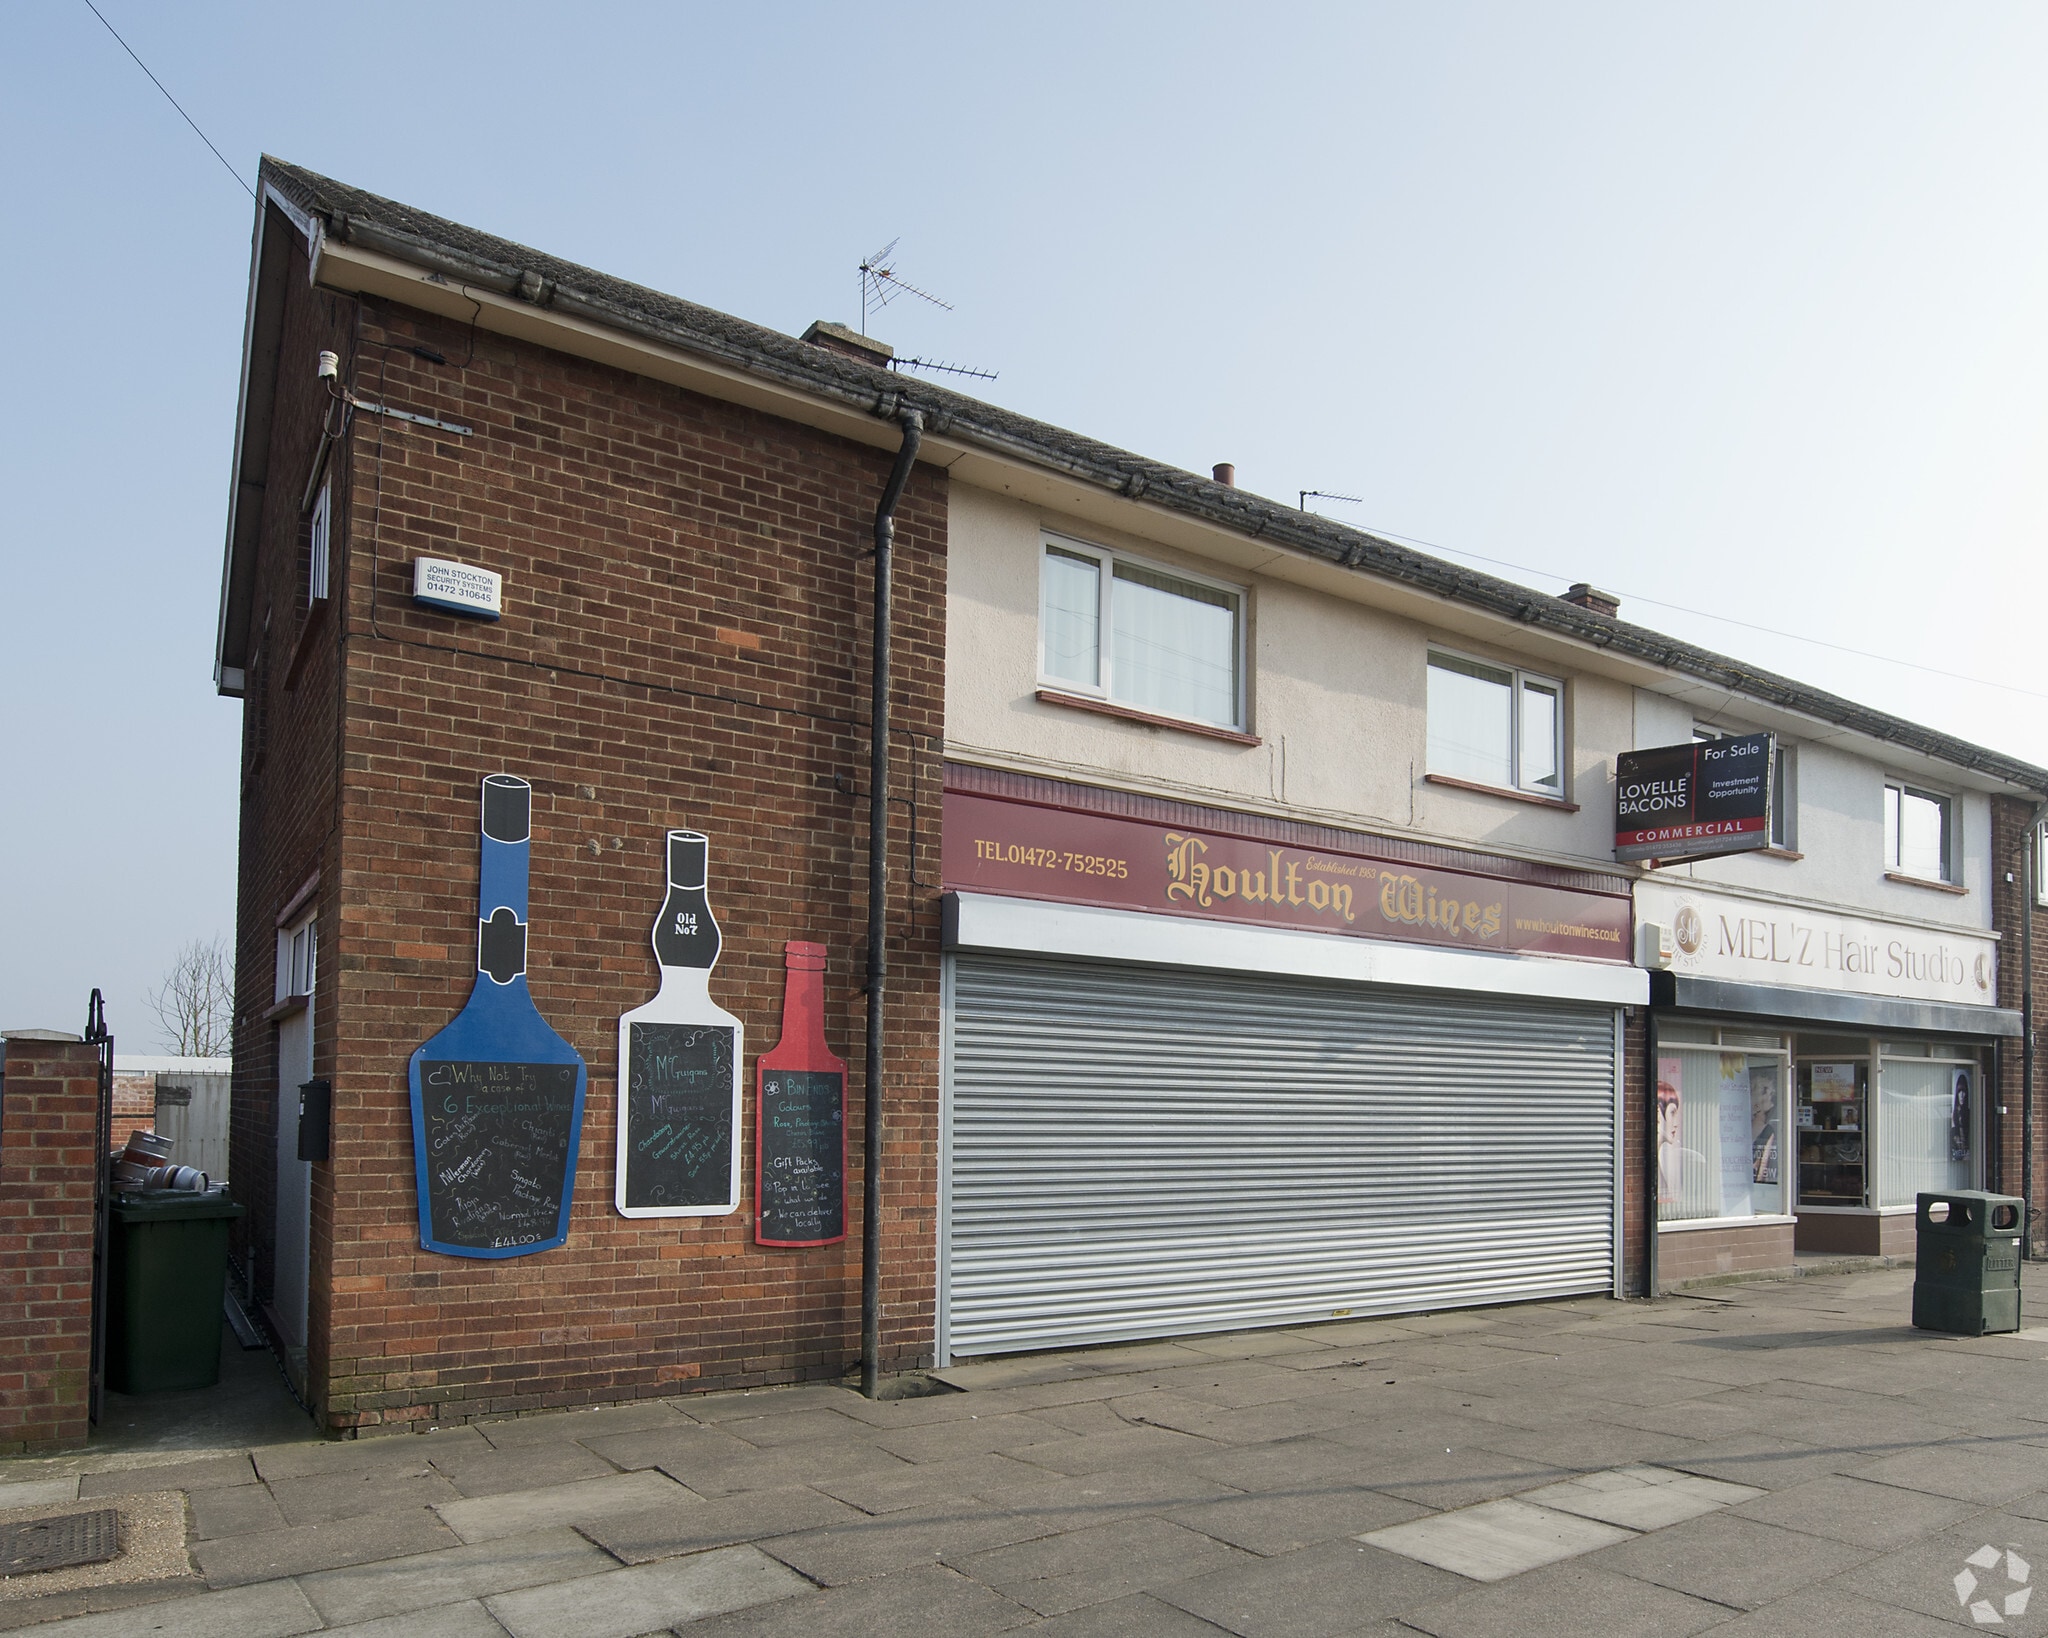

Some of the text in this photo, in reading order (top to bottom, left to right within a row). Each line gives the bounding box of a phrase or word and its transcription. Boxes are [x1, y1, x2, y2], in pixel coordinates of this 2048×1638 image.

[426, 573, 493, 594] SECURITY SYSTEMS
[427, 565, 493, 586] JOHN STOCKTON
[427, 581, 491, 603] 01472 310645
[1704, 742, 1759, 761] For Sale
[1619, 777, 1687, 800] LOVELLE
[1708, 785, 1760, 799] Opportunity
[1712, 775, 1760, 788] Investment
[1619, 794, 1687, 815] BACONS
[1635, 821, 1744, 842] COMMERCIAL
[1306, 855, 1377, 879] Established 1983
[1164, 832, 1503, 939] Houlton Wines
[677, 911, 697, 925] Old
[1514, 916, 1621, 943] www.houltonwines.co.uk
[1717, 914, 1814, 967] MEL'Z
[1824, 931, 1878, 974] Hair
[1887, 940, 1965, 986] Studio
[451, 1064, 537, 1091] Why Not Try
[443, 1095, 459, 1114] 6
[466, 1095, 542, 1118] Exceptional
[773, 1156, 819, 1170] Gift Packs
[773, 1181, 788, 1196] Pop
[794, 1216, 822, 1232] locally
